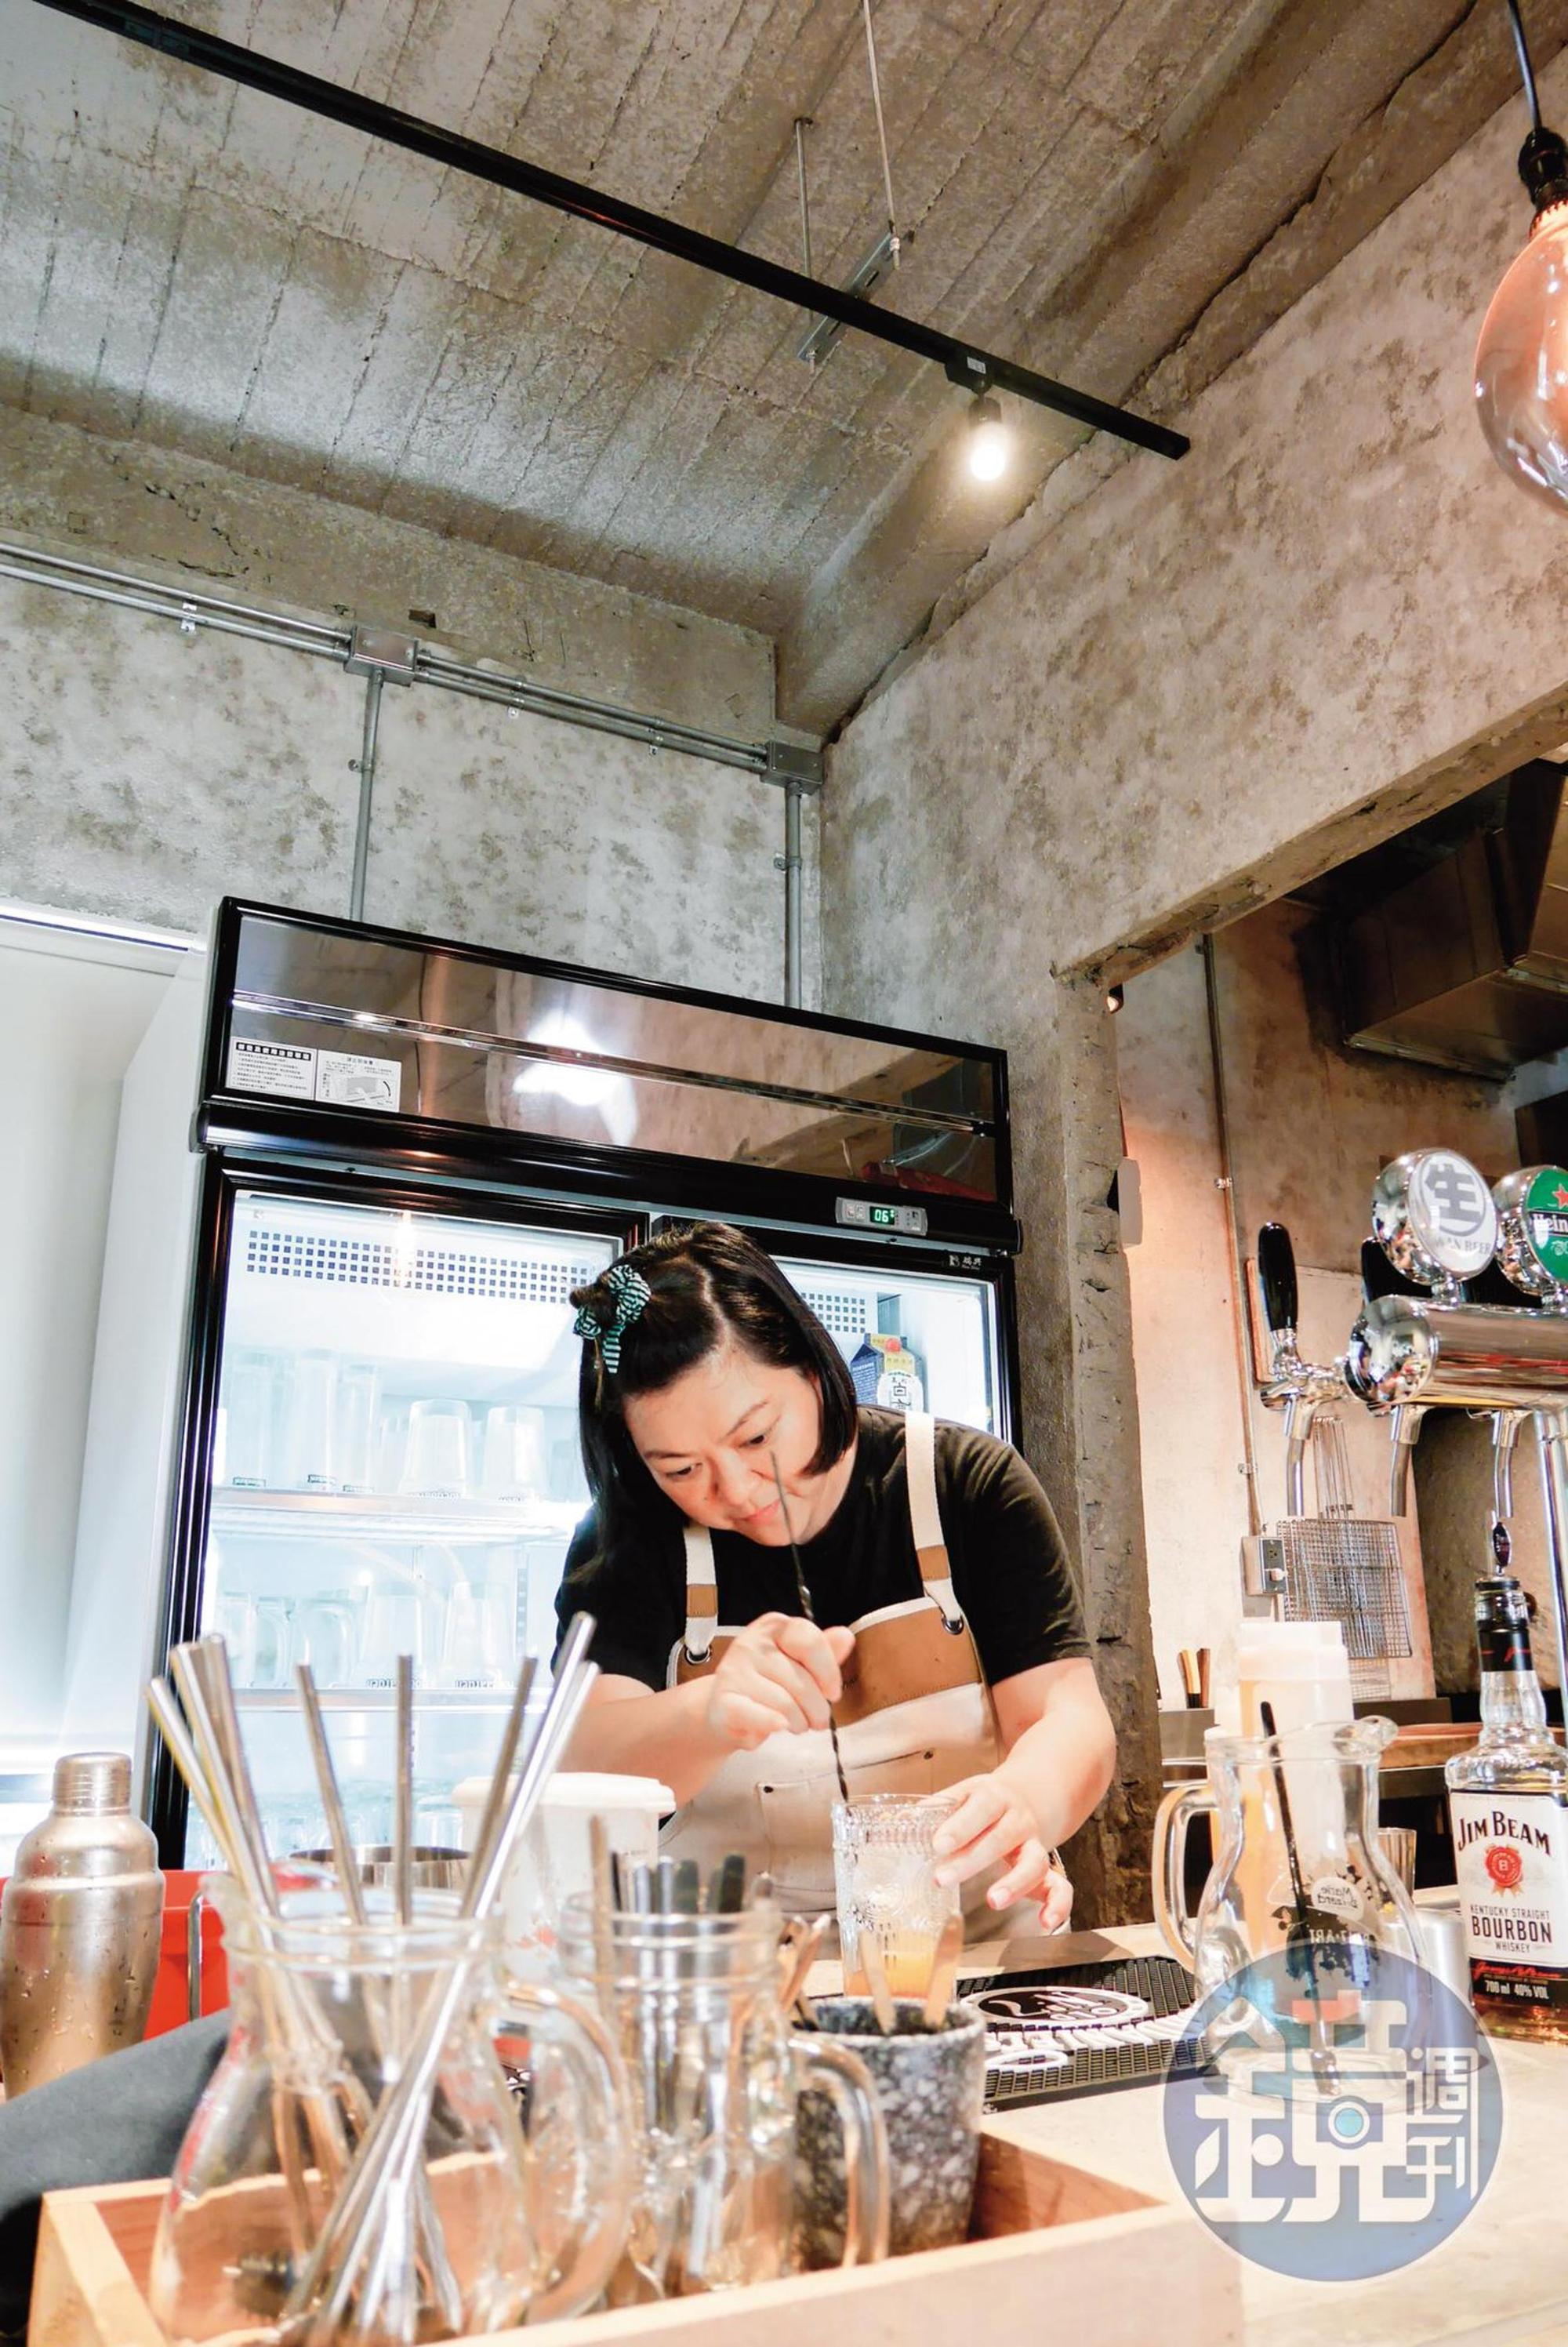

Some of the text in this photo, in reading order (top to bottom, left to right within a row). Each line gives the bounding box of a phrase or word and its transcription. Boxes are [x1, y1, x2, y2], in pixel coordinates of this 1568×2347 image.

[1424, 1164, 1482, 1223] 生
[1532, 1213, 1568, 1233] ein
[1458, 1811, 1552, 1856] JIM BEAM
[1470, 1905, 1550, 1920] KENTUCKY STRAIGHT
[1472, 1916, 1552, 1943] BOURBON
[1496, 1942, 1530, 1953] WHISKEY
